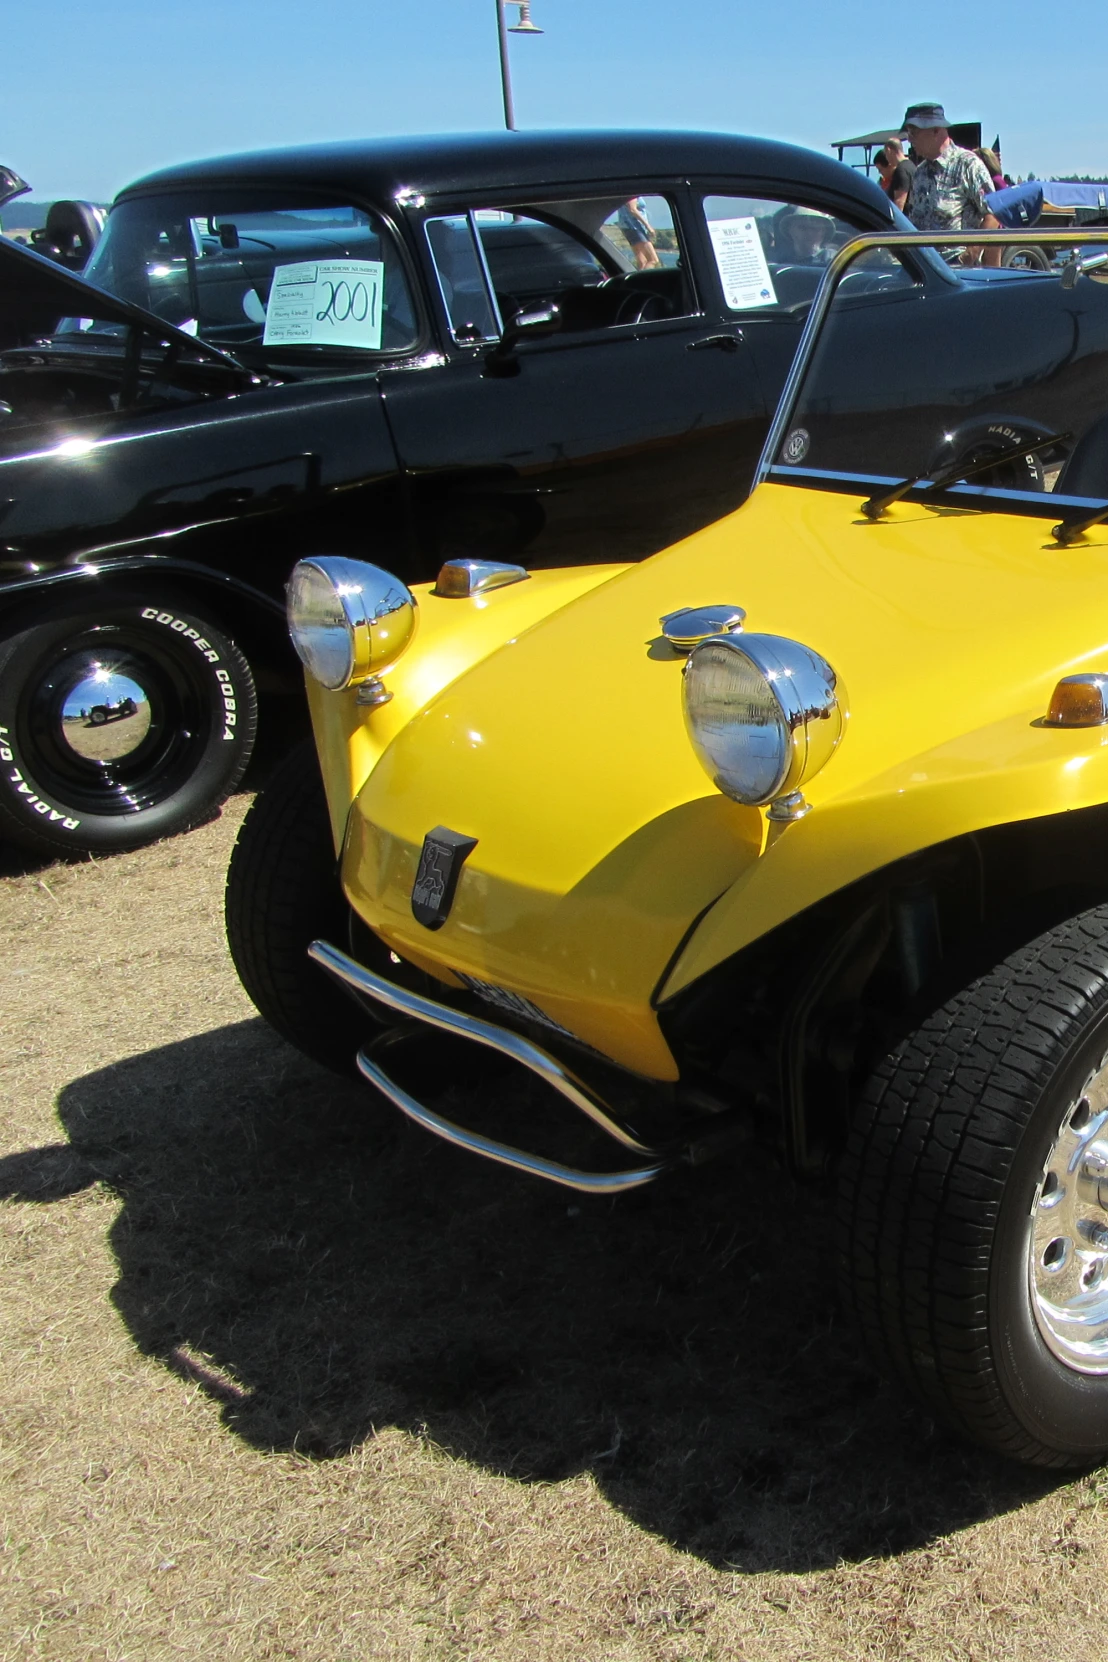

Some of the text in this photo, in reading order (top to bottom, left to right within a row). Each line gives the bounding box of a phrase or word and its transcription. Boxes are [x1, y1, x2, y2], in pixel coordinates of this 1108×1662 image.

[316, 281, 377, 327] 2001
[141, 608, 237, 741] COOPER COBRA
[10, 767, 81, 831] RADIAL
